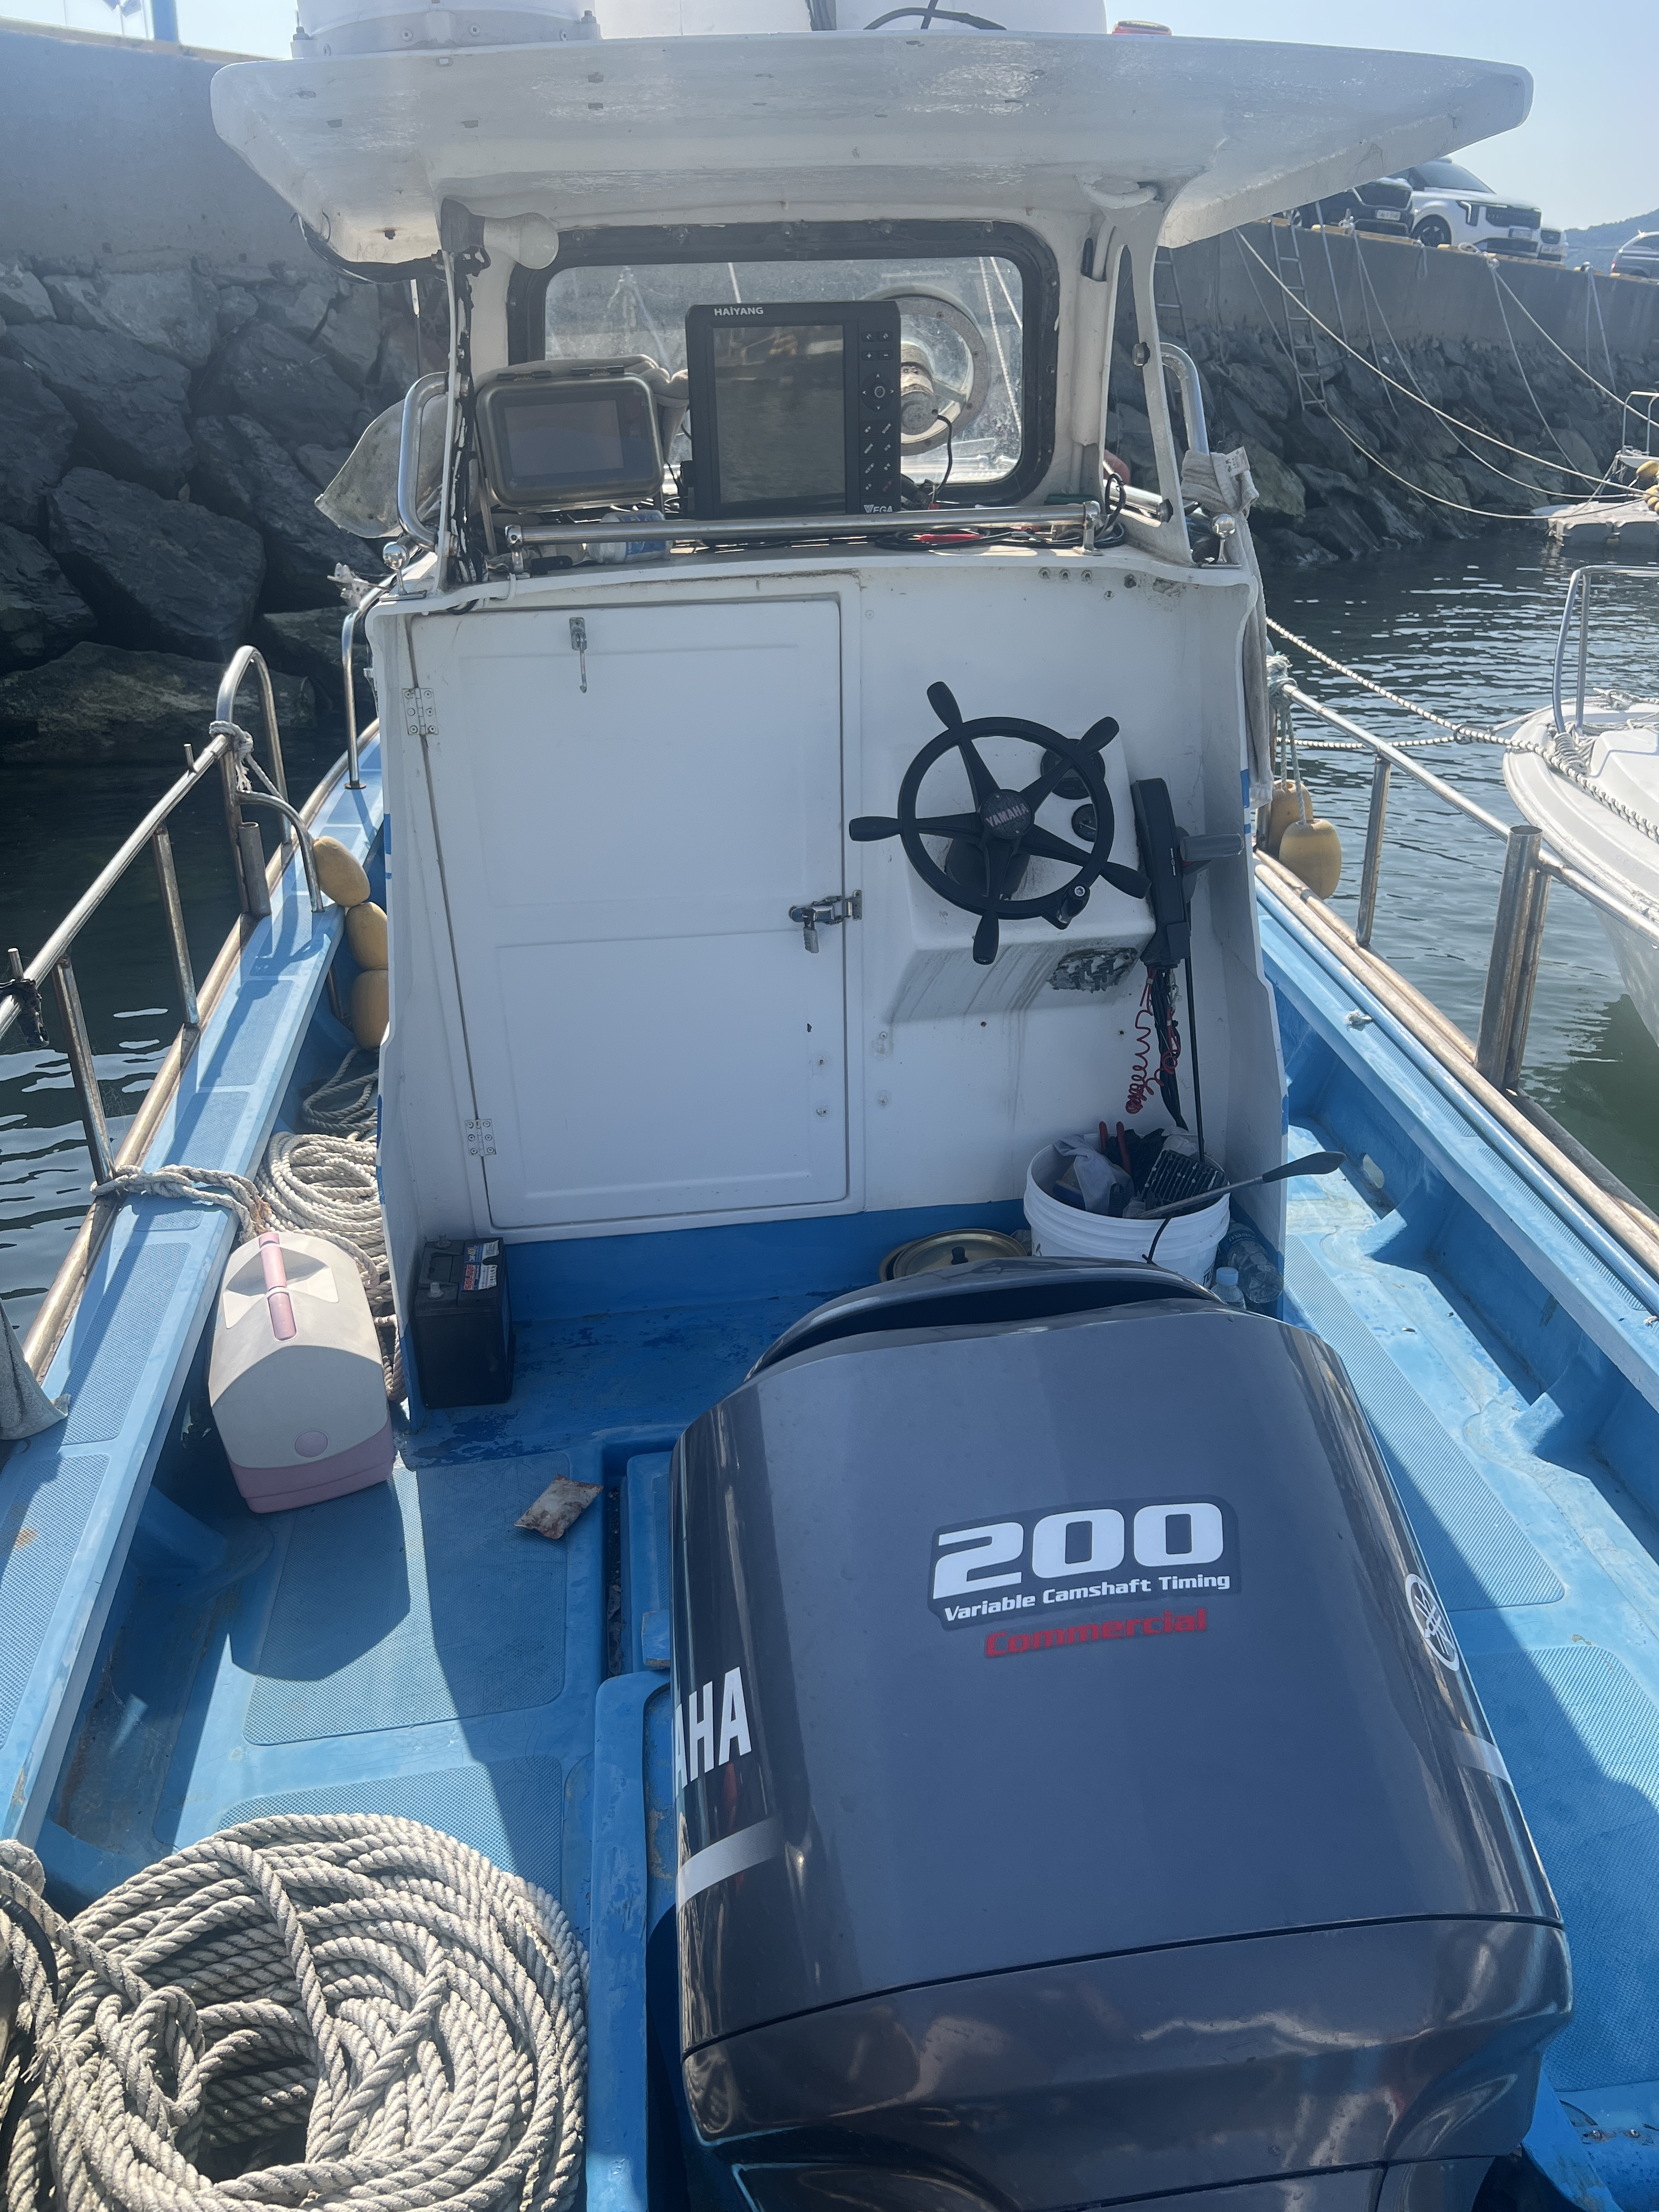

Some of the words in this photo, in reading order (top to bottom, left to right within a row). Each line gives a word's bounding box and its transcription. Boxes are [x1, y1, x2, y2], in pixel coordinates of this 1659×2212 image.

[864, 504, 893, 514] VEGA
[985, 803, 1029, 827] YAMAHA
[464, 1265, 475, 1290] SOLITE
[933, 1503, 1224, 1600] 200
[944, 1593, 1036, 1622] Variable
[1043, 1578, 1152, 1604] Camshaft
[1158, 1574, 1231, 1590] Timing
[985, 1609, 1208, 1657] Commercial
